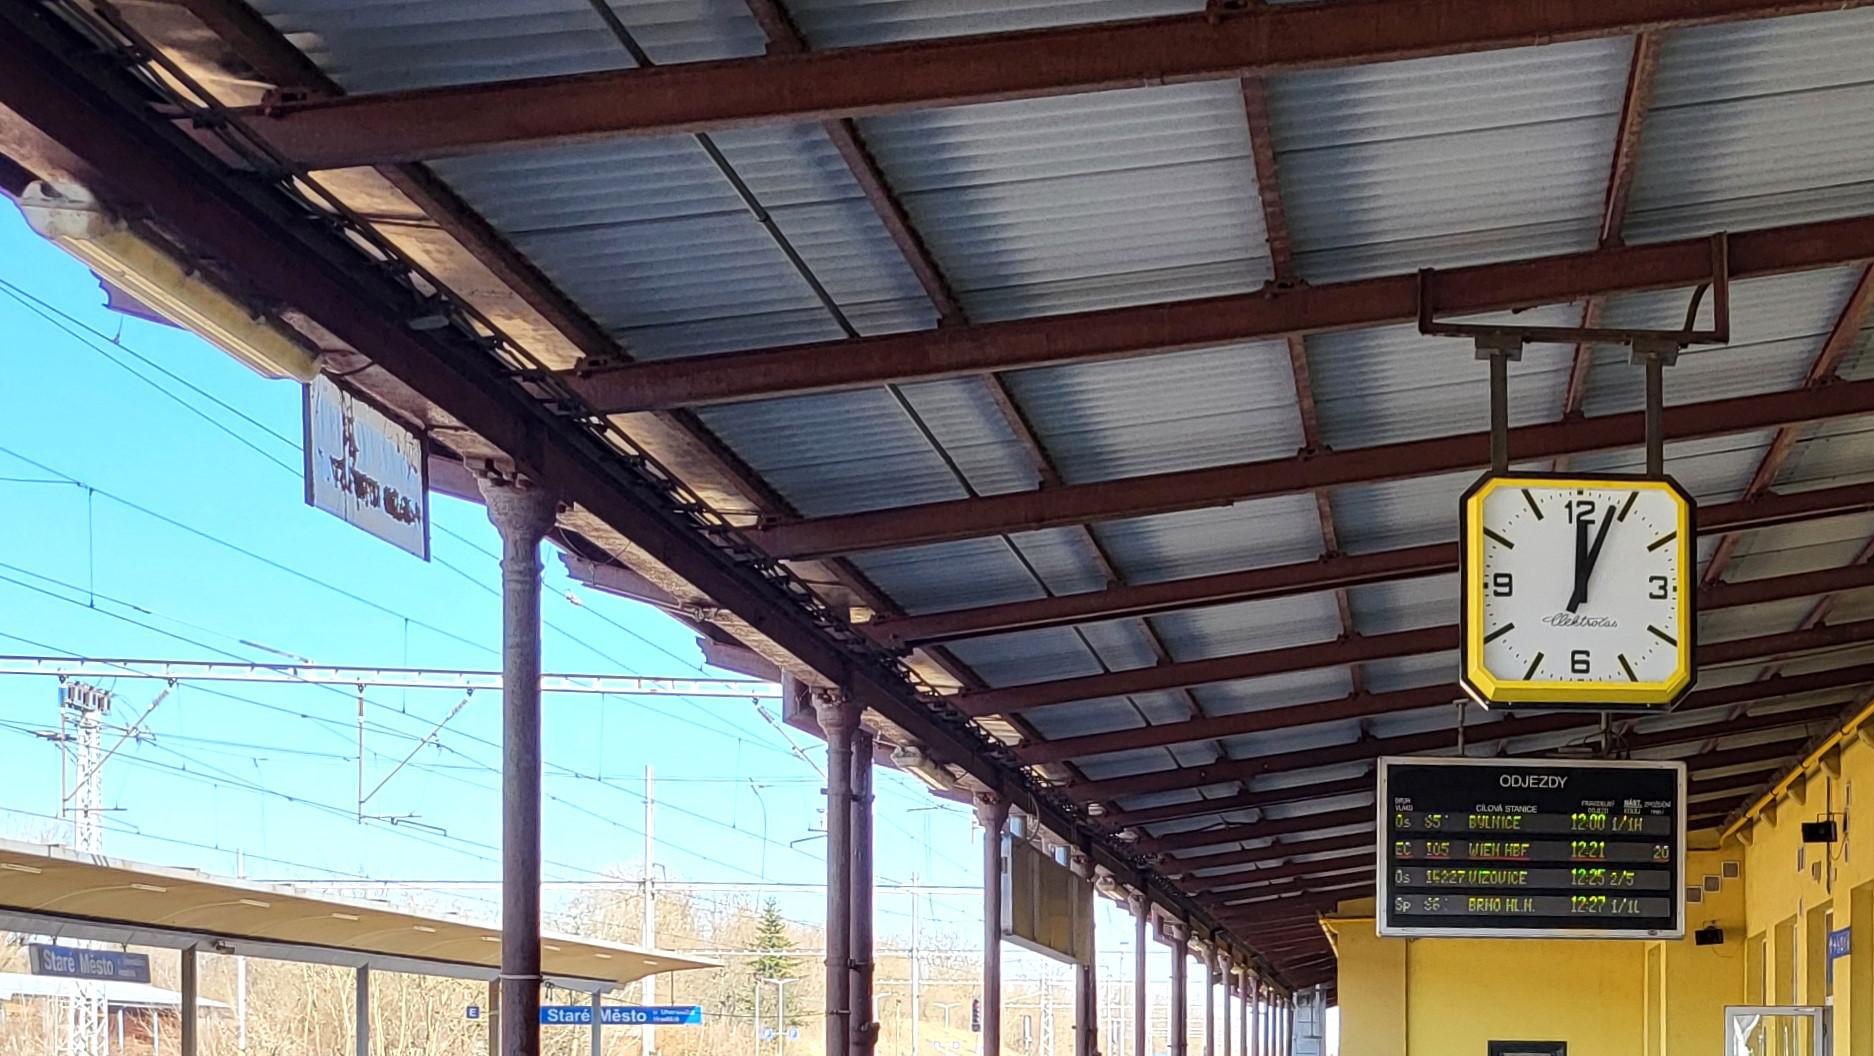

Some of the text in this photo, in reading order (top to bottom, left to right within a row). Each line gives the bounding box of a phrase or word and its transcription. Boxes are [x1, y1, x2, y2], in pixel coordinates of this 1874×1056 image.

[1564, 500, 1596, 524] 12
[1493, 573, 1513, 597] 9
[1648, 575, 1669, 600] 3
[1570, 650, 1591, 674] 6
[1499, 774, 1568, 789] ODJEZDY
[1505, 805, 1538, 813] STANICE
[1571, 813, 1606, 832] 12:00
[1395, 842, 1412, 857] EC
[1571, 841, 1606, 858] 12:21
[1653, 845, 1670, 860] 20
[1468, 870, 1528, 885] VIZOVICE
[1571, 868, 1606, 886] 12:25
[1468, 897, 1501, 913] BRNO
[1571, 895, 1606, 913] 12:27
[43, 949, 76, 973] Staré
[80, 952, 114, 976] Město
[547, 1008, 591, 1023] Staré
[600, 1008, 647, 1023] Město
